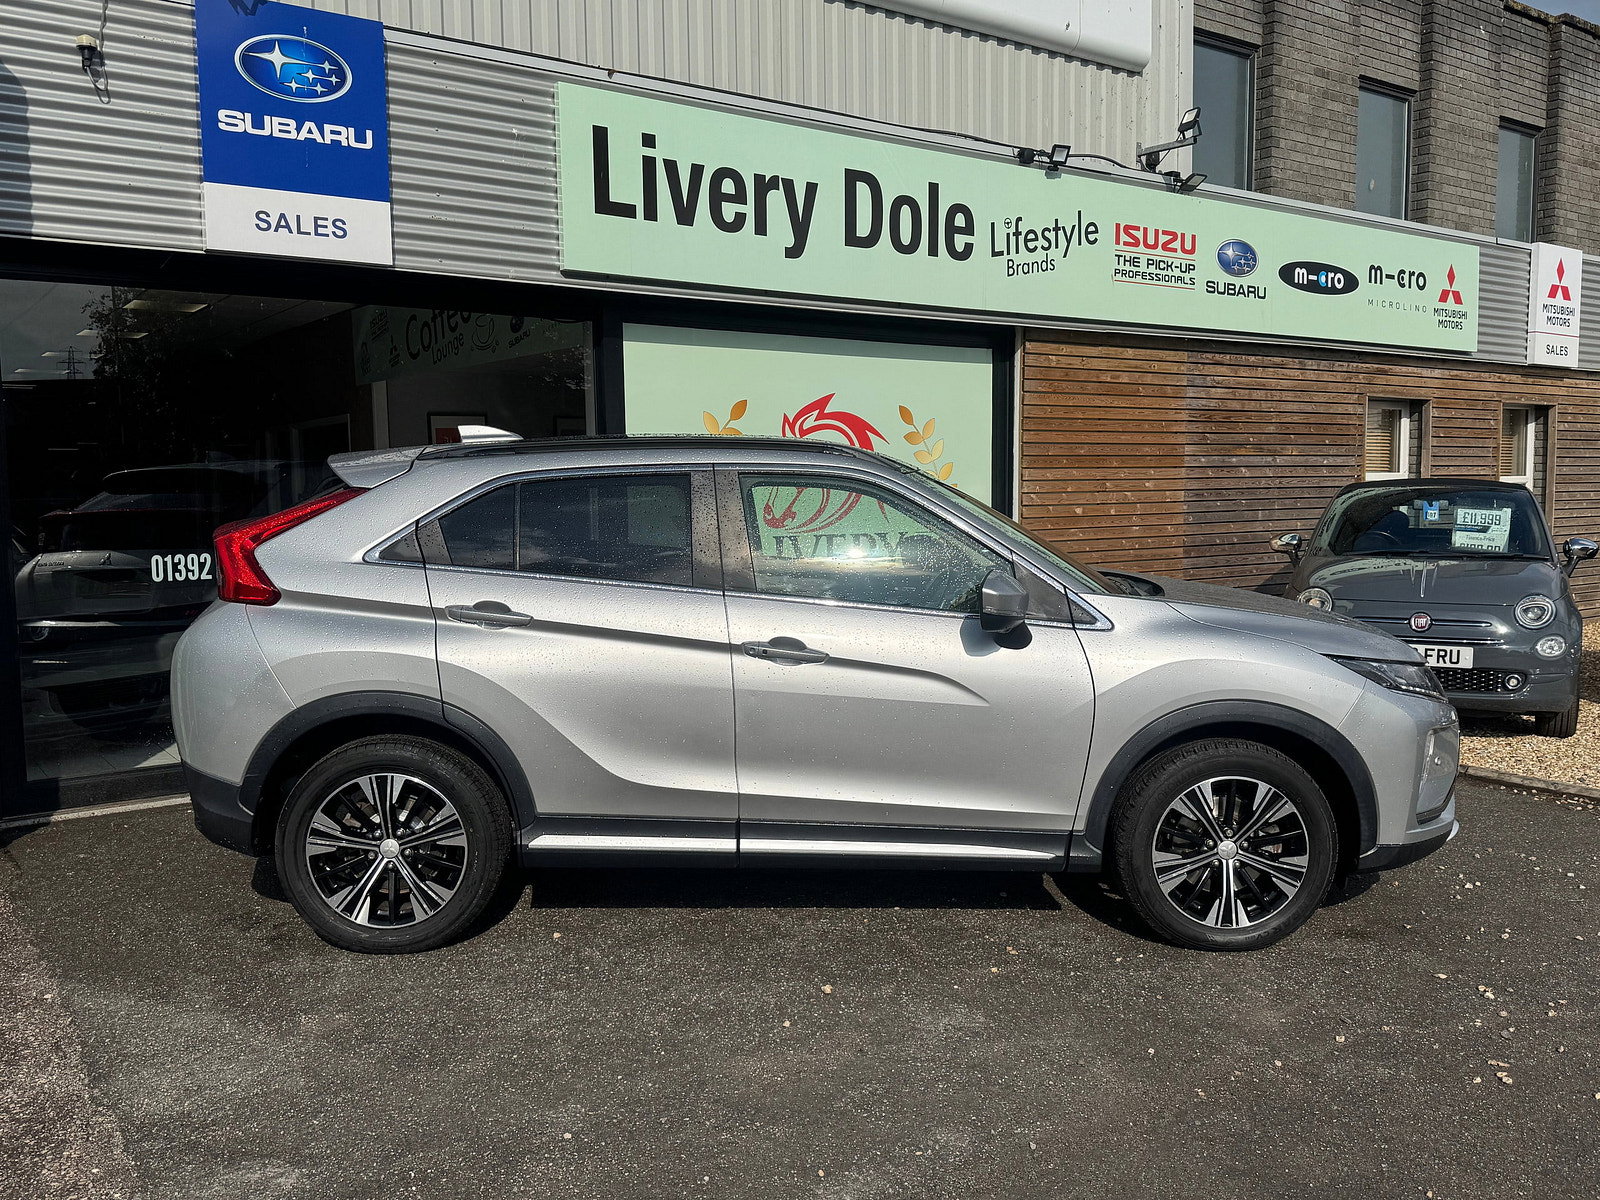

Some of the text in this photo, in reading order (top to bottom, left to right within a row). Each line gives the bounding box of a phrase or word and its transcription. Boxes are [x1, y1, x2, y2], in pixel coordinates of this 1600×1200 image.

[217, 108, 374, 150] SUBARU
[592, 124, 975, 262] Livery Dole
[254, 210, 348, 240] SALES
[990, 210, 1100, 258] Lifestyle
[1114, 222, 1197, 255] ISUZU
[1006, 252, 1056, 277] Brands
[1114, 254, 1197, 275] THE PICK-UP
[1114, 268, 1197, 286] PROFESSIONALS
[1205, 280, 1267, 300] SUBARU
[1367, 298, 1428, 314] MICROLINO
[1433, 307, 1468, 321] MITSUBISHI
[1542, 302, 1576, 318] MITSUBISHI
[1437, 318, 1463, 331] MOTORS
[1546, 315, 1571, 329] MOTORS
[432, 333, 465, 366] Lounge
[1545, 344, 1569, 357] SALES
[1462, 512, 1502, 526] £11,999
[151, 553, 212, 583] 01392
[1415, 618, 1428, 628] FIAT
